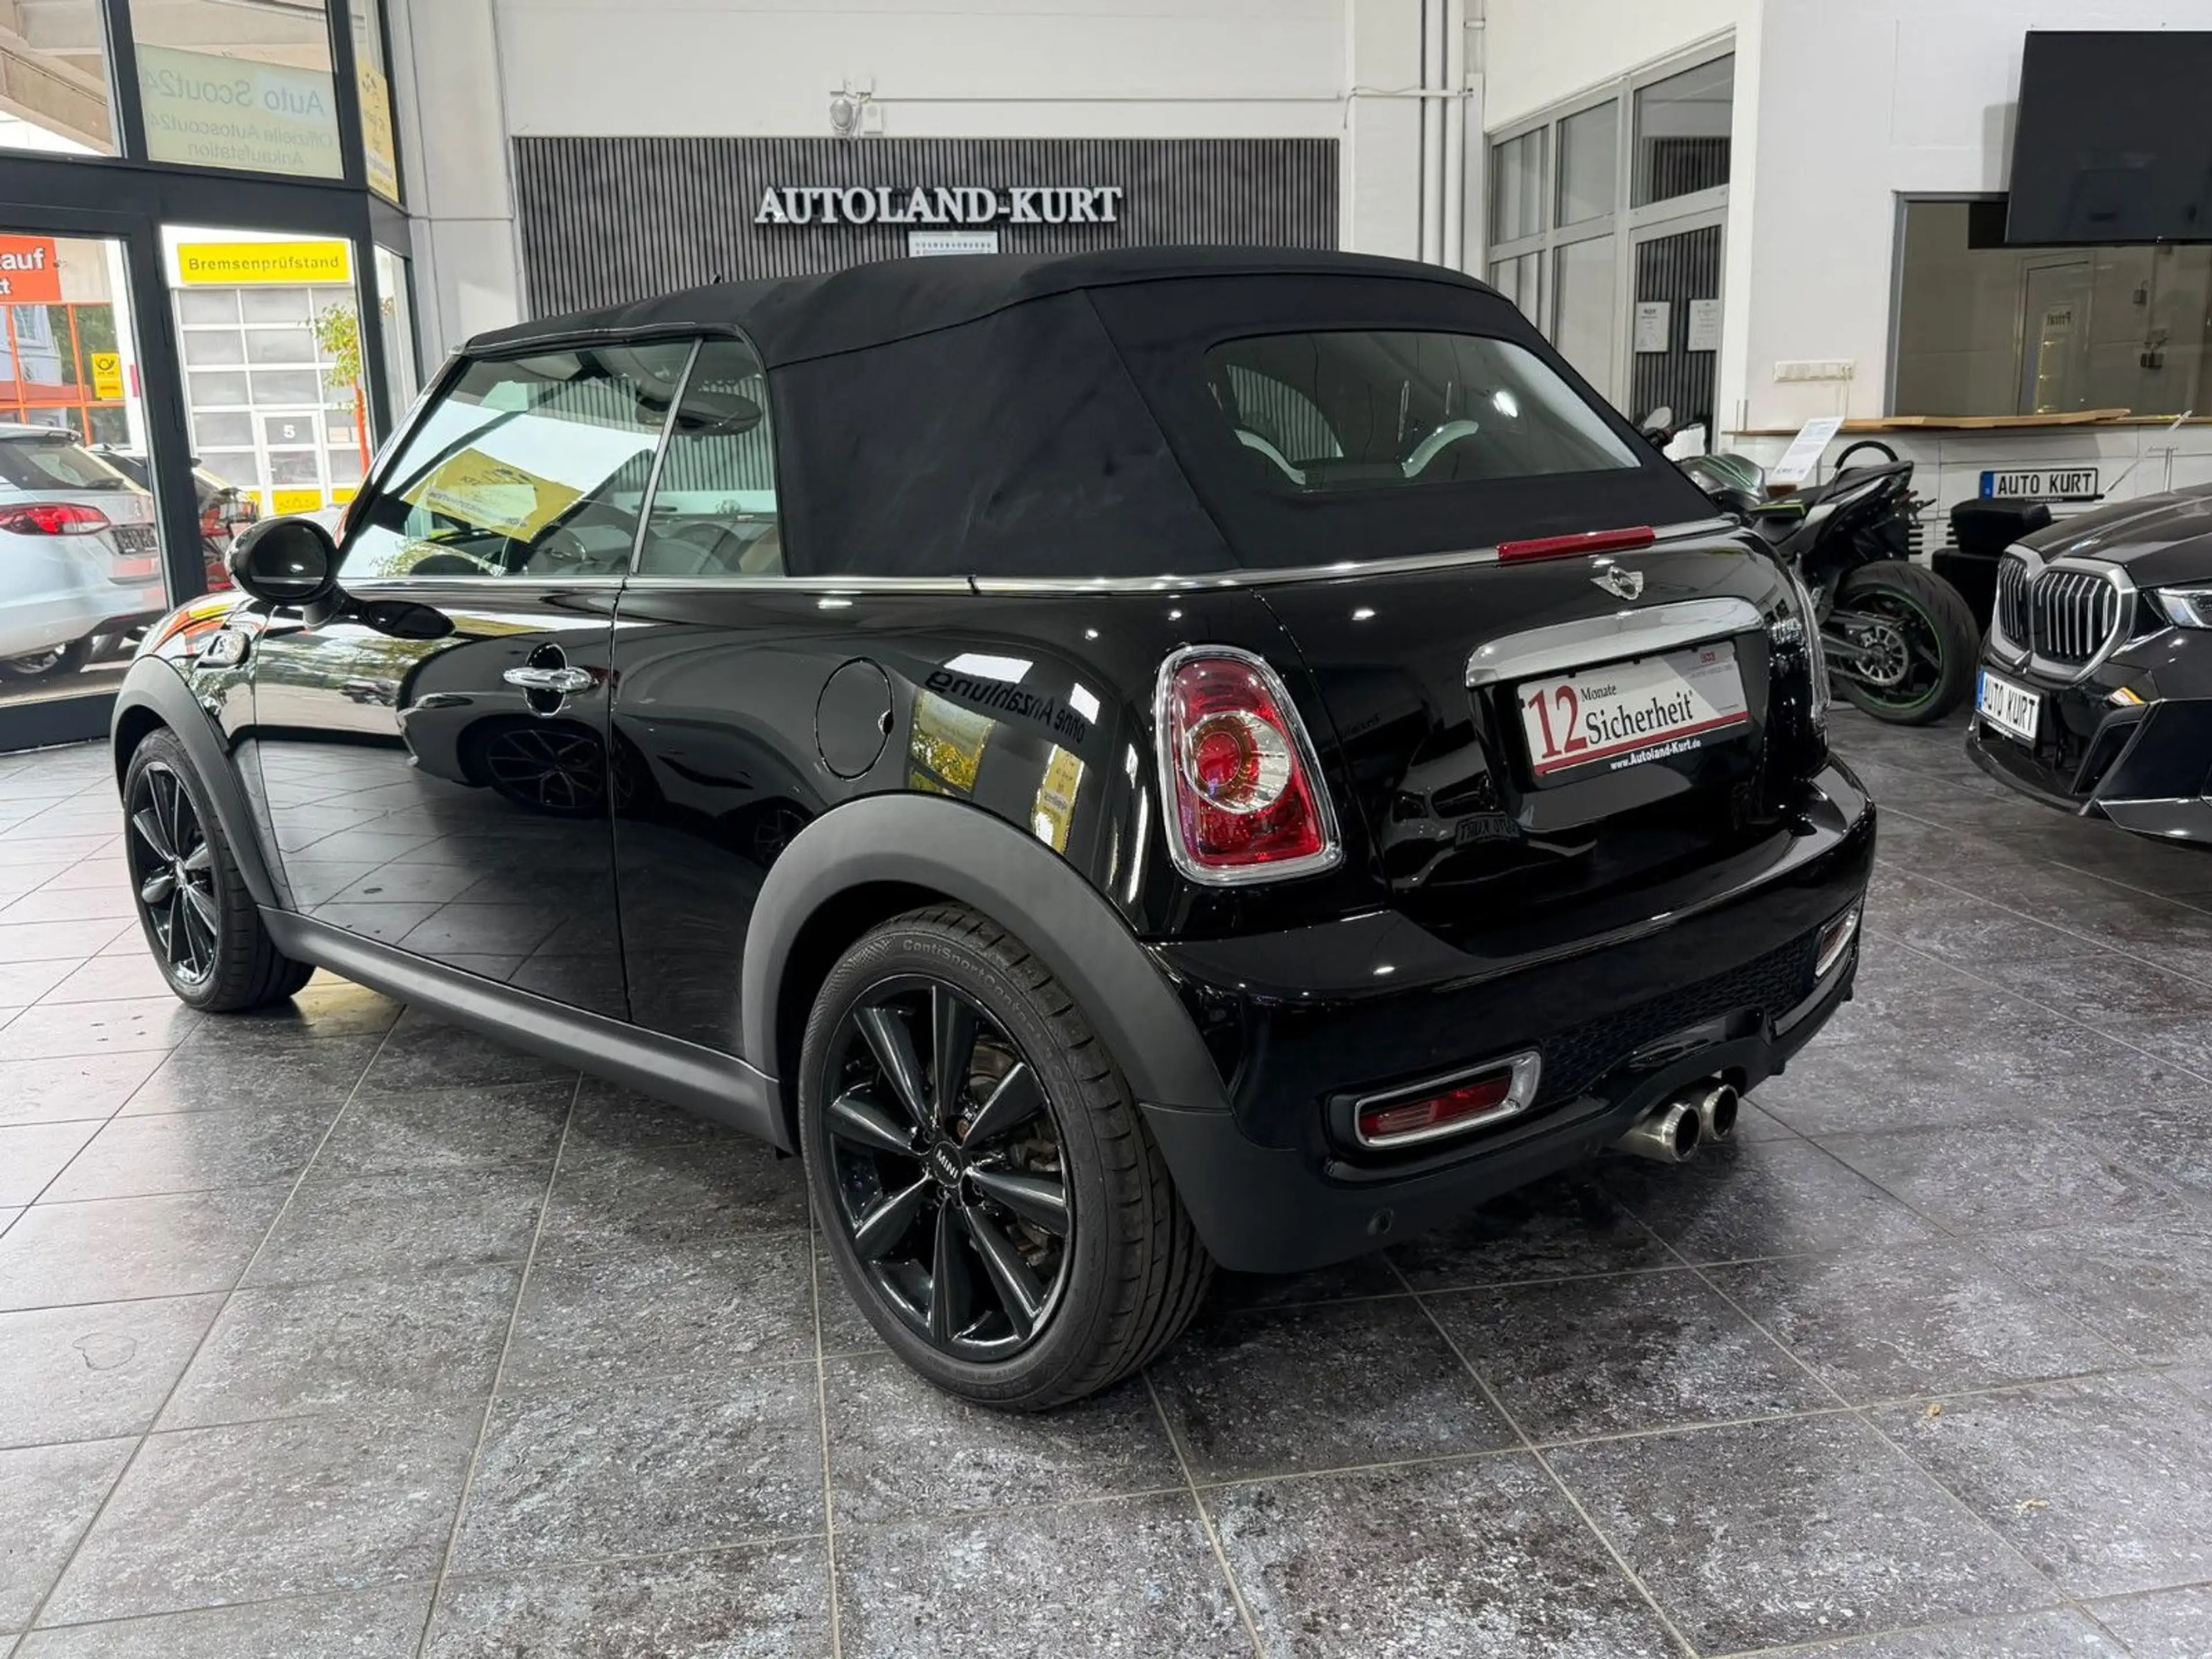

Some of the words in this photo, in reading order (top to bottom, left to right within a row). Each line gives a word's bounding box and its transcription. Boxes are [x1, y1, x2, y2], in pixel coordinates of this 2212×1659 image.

[754, 185, 1123, 225] AUTOLAND-KURT
[0, 247, 45, 271] auf
[188, 256, 339, 272] Bremsenprüfstand
[283, 424, 296, 438] 5
[1998, 474, 2040, 495] AUTO
[2049, 473, 2092, 493] KURT
[1580, 683, 1617, 702] Monate
[1528, 685, 1588, 759] 12
[2006, 689, 2035, 731] KURT
[1610, 739, 1702, 770] www.Autoland-Kurt.de
[935, 1149, 959, 1179] MINI
